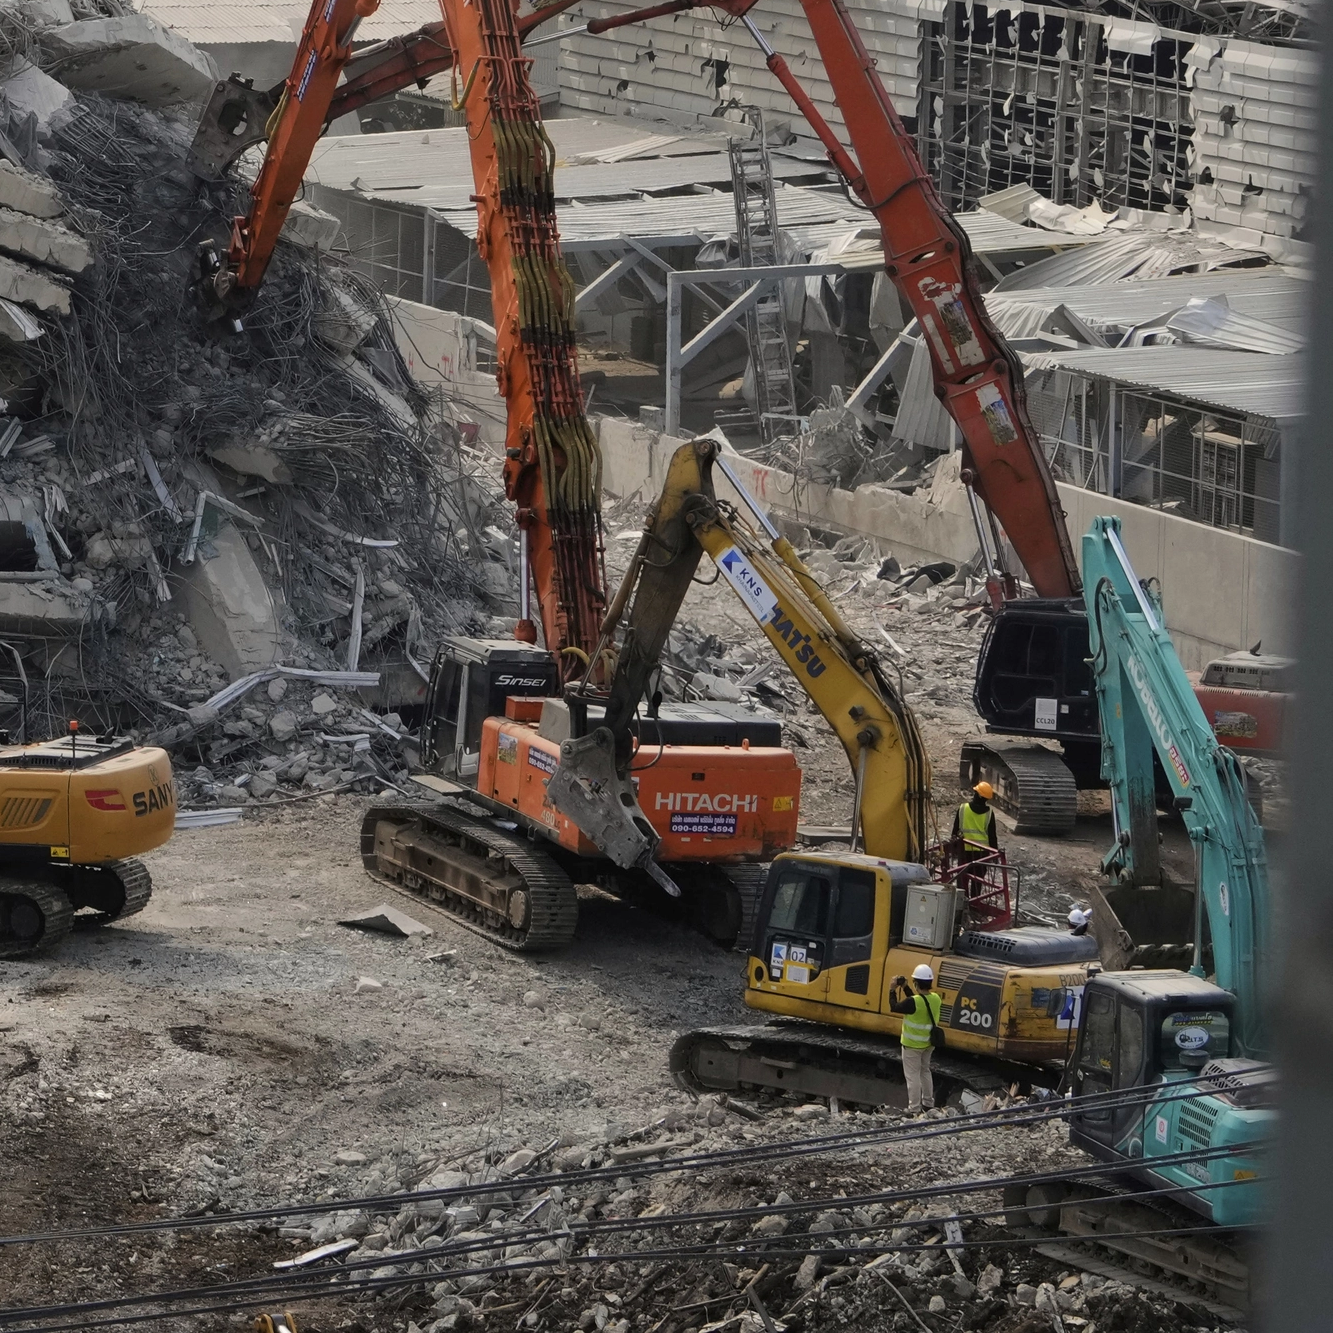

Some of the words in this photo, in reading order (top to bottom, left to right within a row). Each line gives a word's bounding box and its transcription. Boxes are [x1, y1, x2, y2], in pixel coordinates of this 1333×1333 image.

[739, 568, 763, 597] KNS
[133, 779, 174, 818] SANY
[655, 792, 758, 813] HITACHI
[671, 824, 735, 833] 090-652-4594
[791, 950, 805, 962] 02
[960, 996, 978, 1010] PC
[959, 1009, 992, 1028] 200
